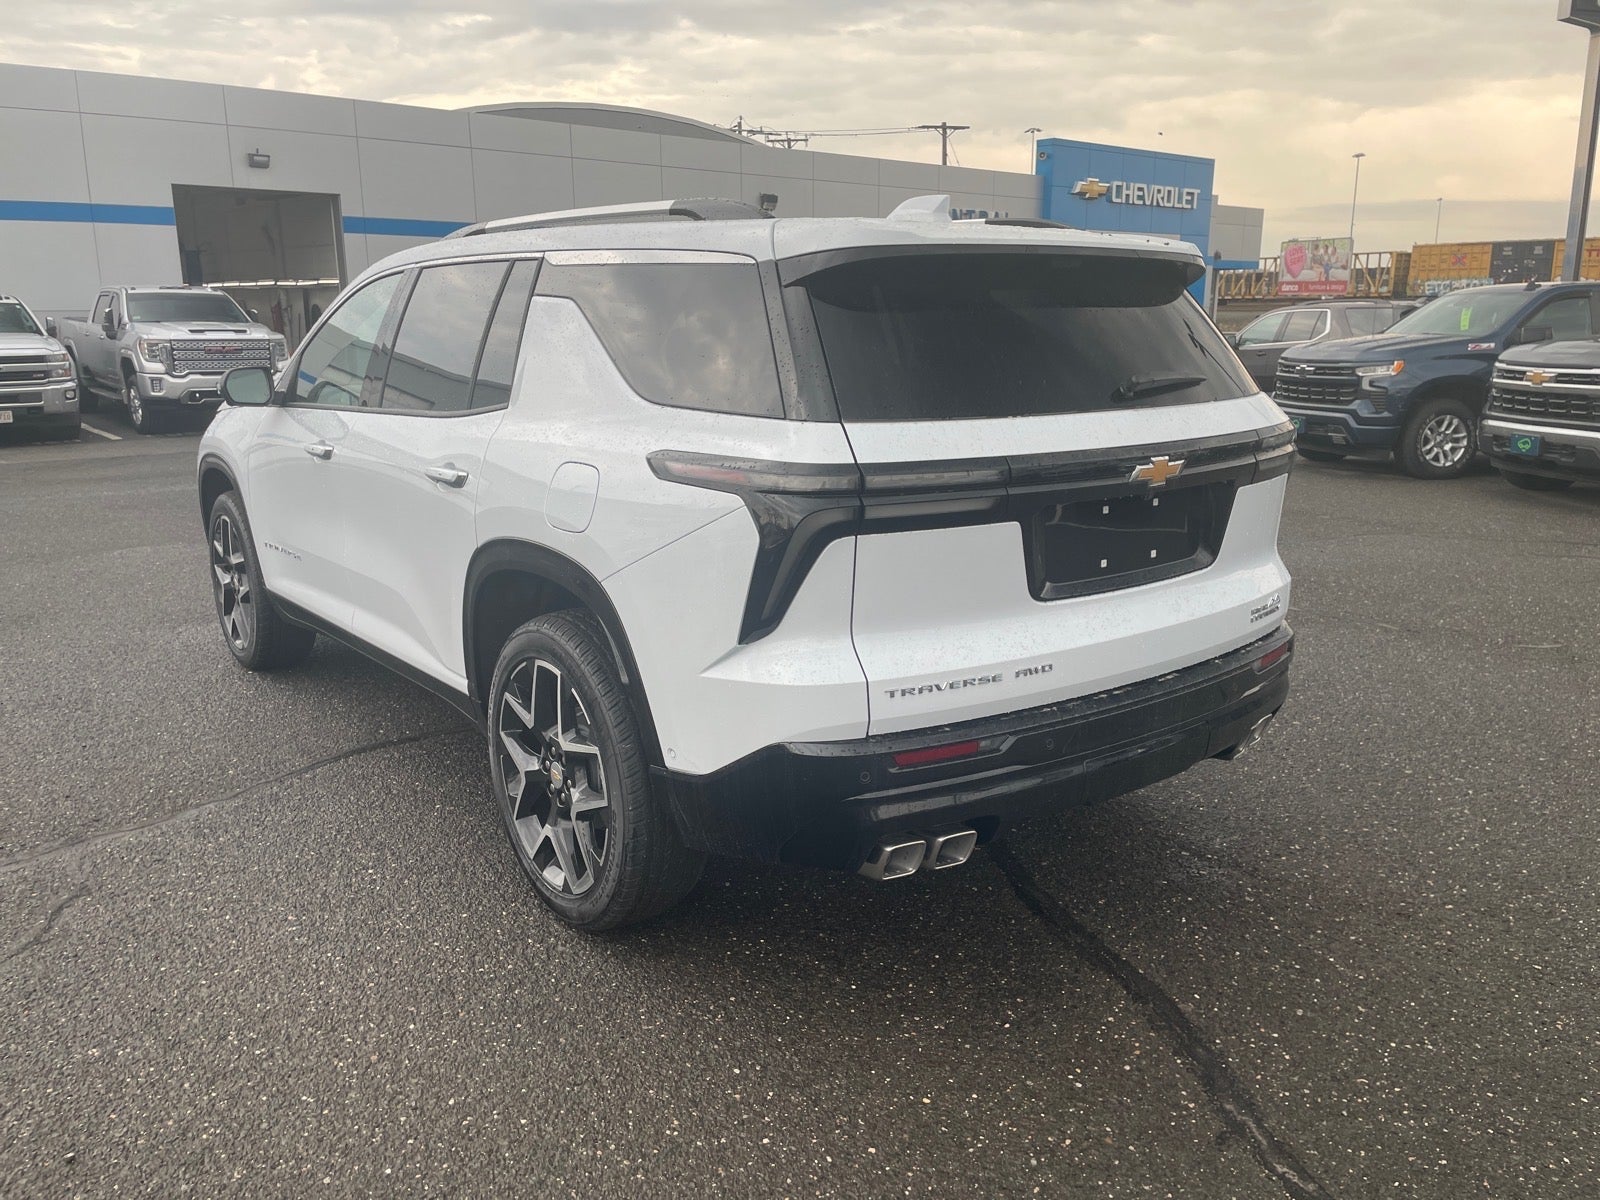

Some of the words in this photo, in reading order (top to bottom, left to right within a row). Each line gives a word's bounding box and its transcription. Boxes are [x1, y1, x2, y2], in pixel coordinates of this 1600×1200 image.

[1111, 180, 1200, 209] CHEVROLET
[884, 673, 1003, 698] TRAVERSE
[1014, 663, 1053, 678] AWD
